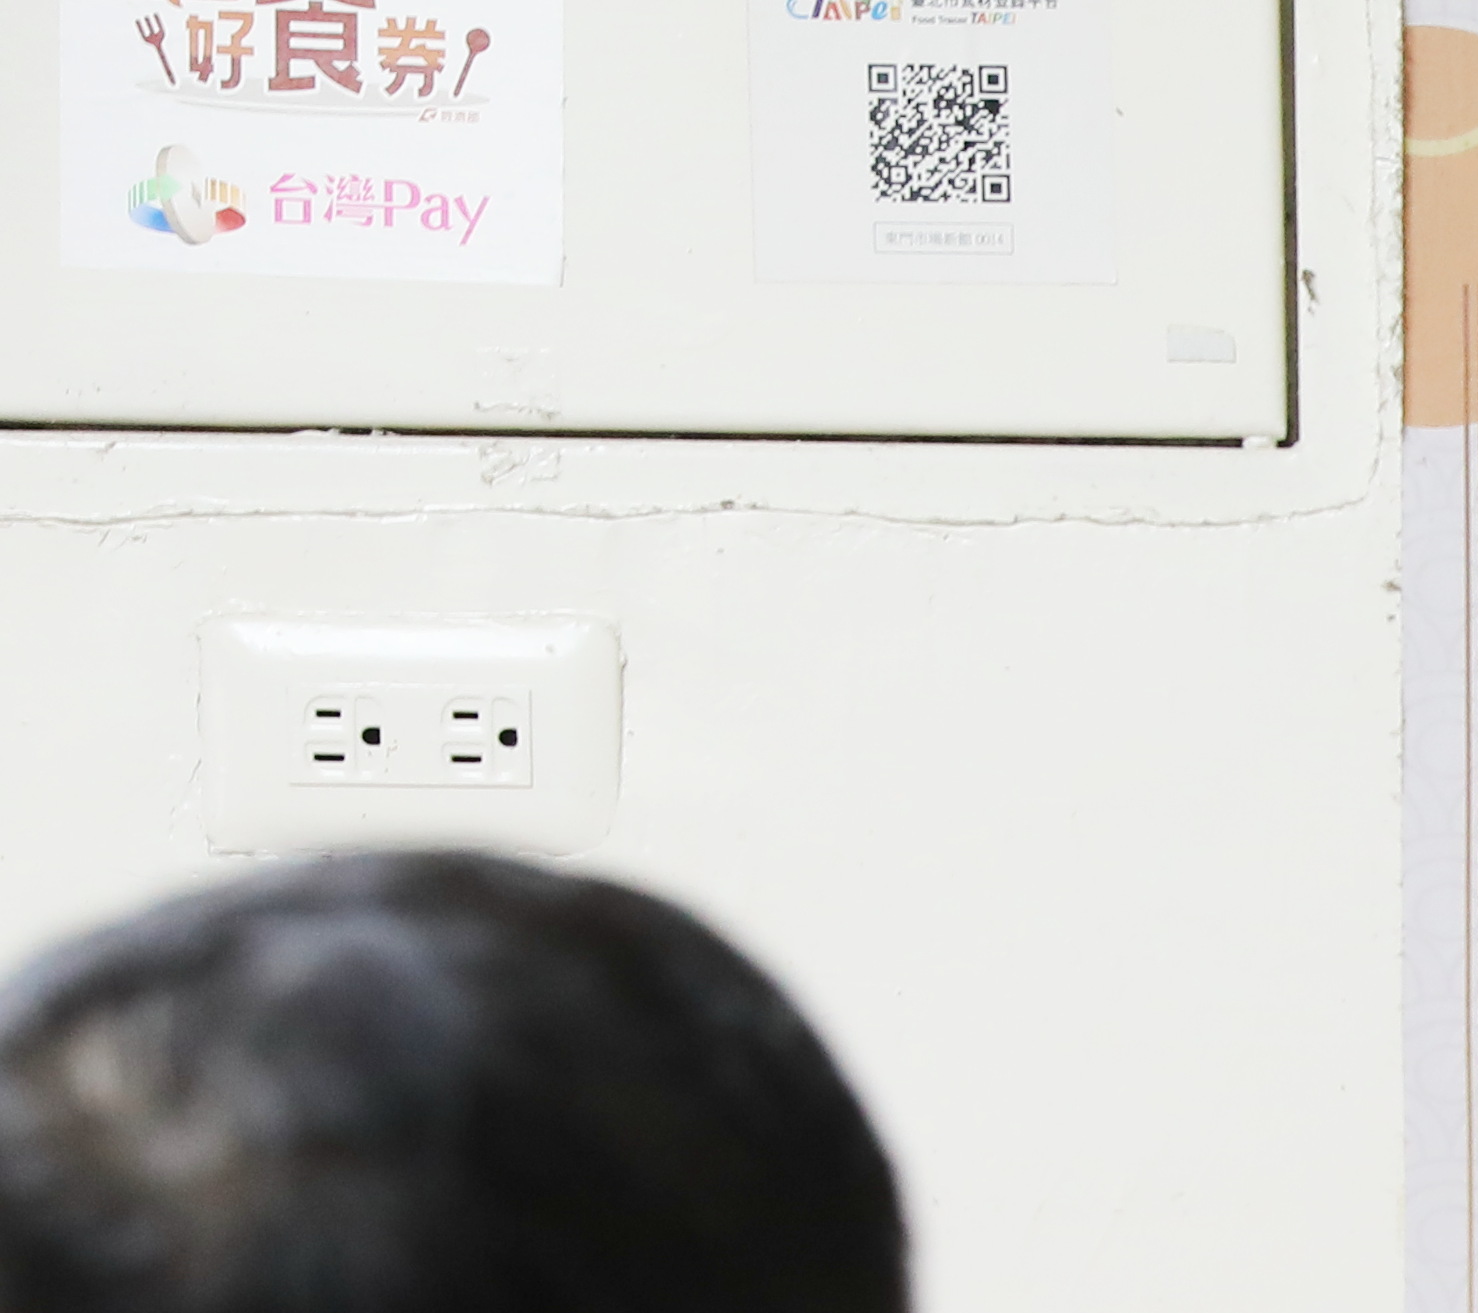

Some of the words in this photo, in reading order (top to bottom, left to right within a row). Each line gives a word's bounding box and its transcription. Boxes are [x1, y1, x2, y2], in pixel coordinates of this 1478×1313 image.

[186, 0, 446, 96] 好食券
[268, 172, 491, 246] 台灣Pay
